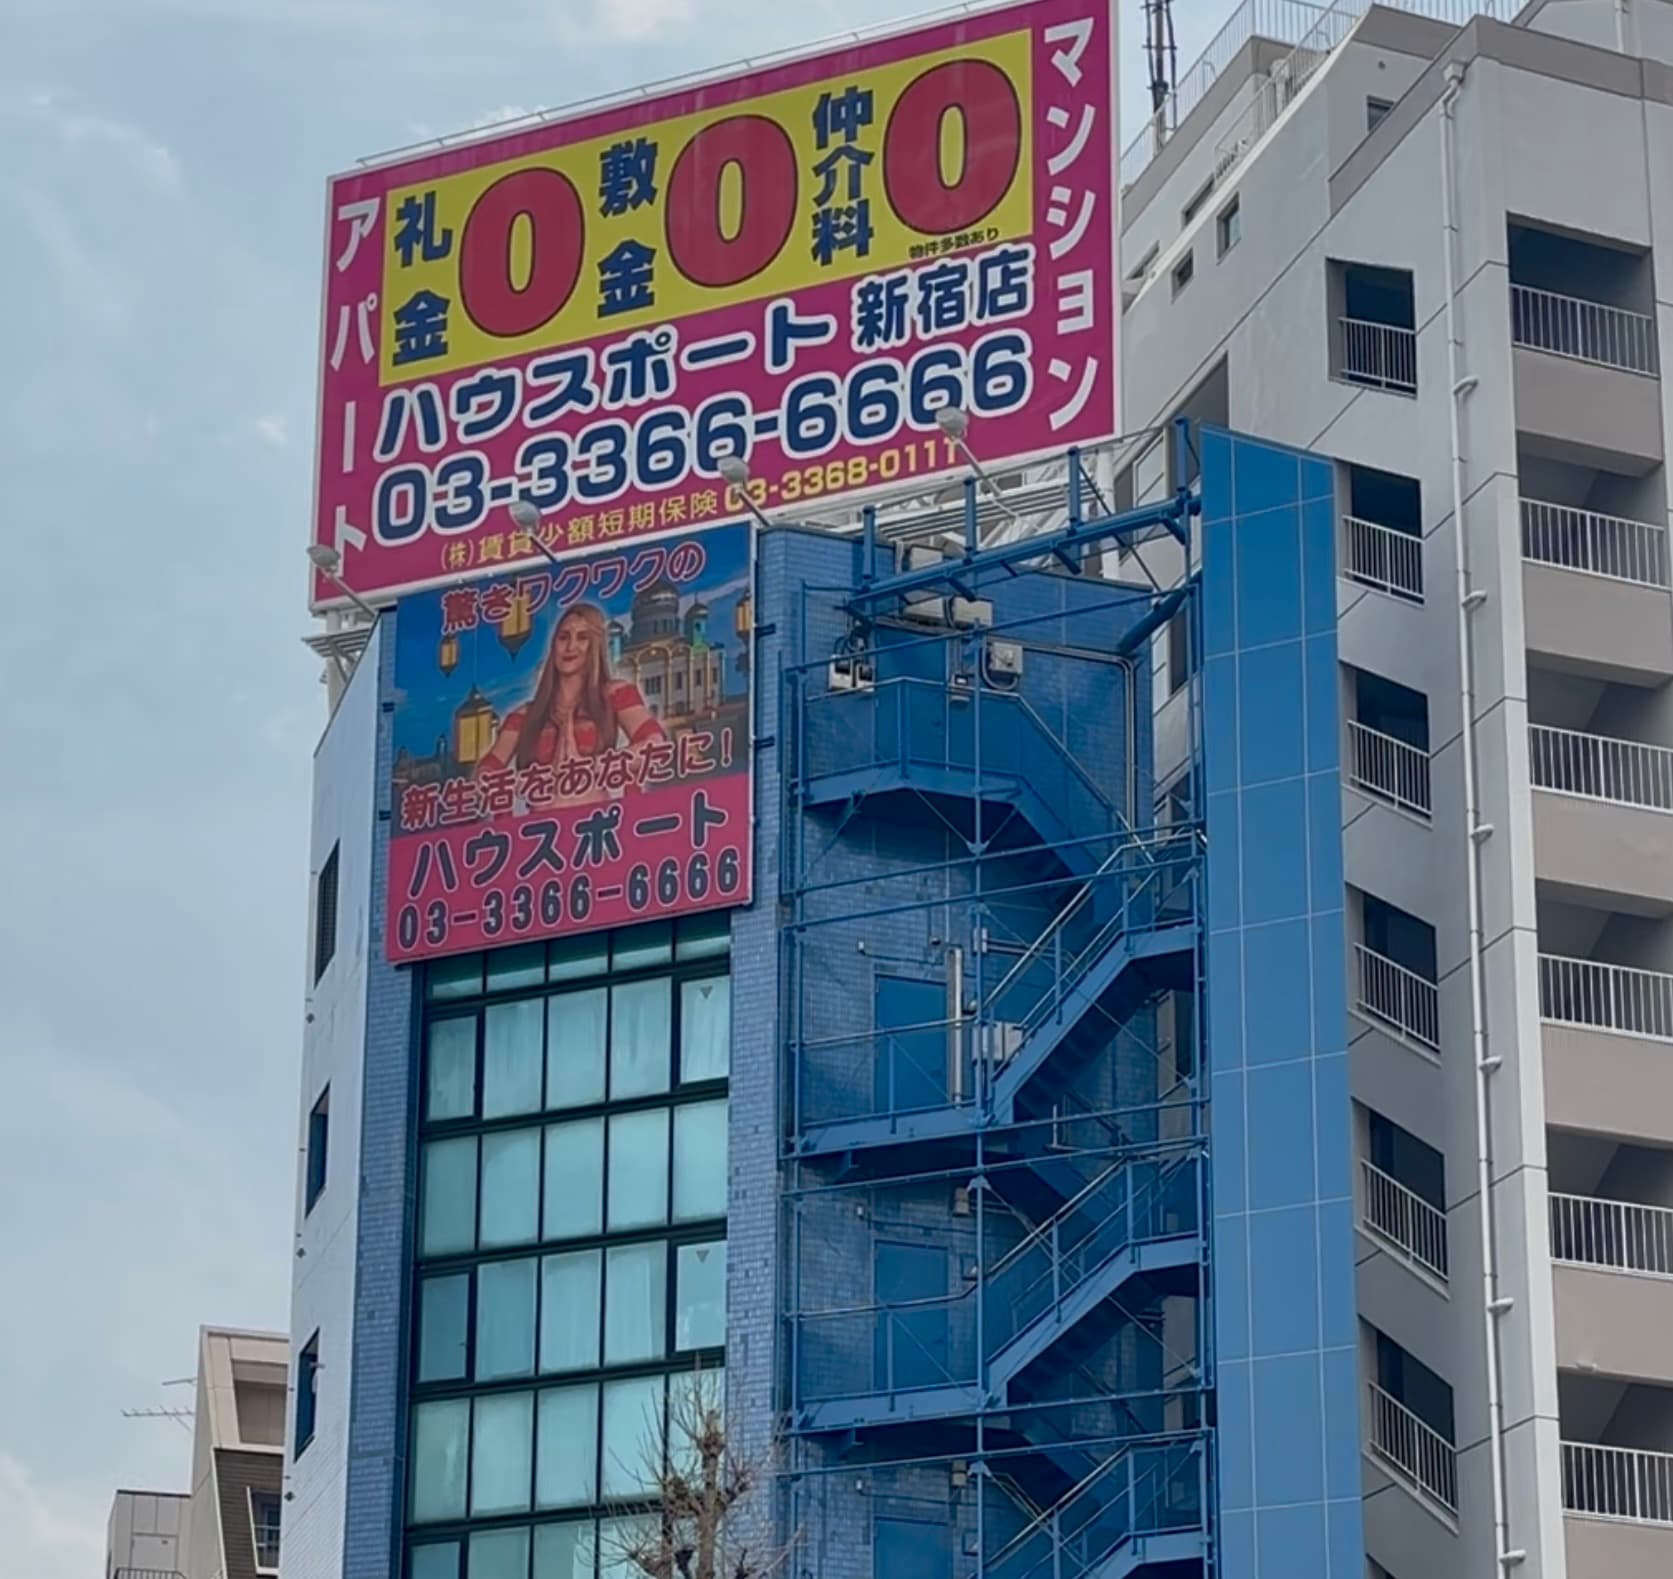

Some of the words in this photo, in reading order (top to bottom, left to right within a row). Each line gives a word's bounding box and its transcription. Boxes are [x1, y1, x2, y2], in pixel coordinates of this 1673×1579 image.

[597, 137, 659, 318] 敷金
[665, 114, 798, 288] 0
[812, 85, 874, 267] 仲介料
[883, 57, 1022, 236] 0
[1044, 16, 1099, 432] マンション
[392, 190, 453, 367] 礼金
[459, 167, 585, 338] 0
[908, 227, 999, 260] 物件多数あり
[329, 197, 381, 577] アパート
[374, 302, 835, 459] ハウスポート
[857, 250, 1030, 349] 新宿店
[374, 333, 1030, 544] 03-3366-6666
[724, 437, 960, 512] 03-3368-0111
[442, 542, 705, 634] 驚きワクワクの
[401, 727, 733, 831] 新生活をあなたに!
[408, 791, 727, 898] ハウスポート
[398, 846, 740, 950] 03-3366-6666
